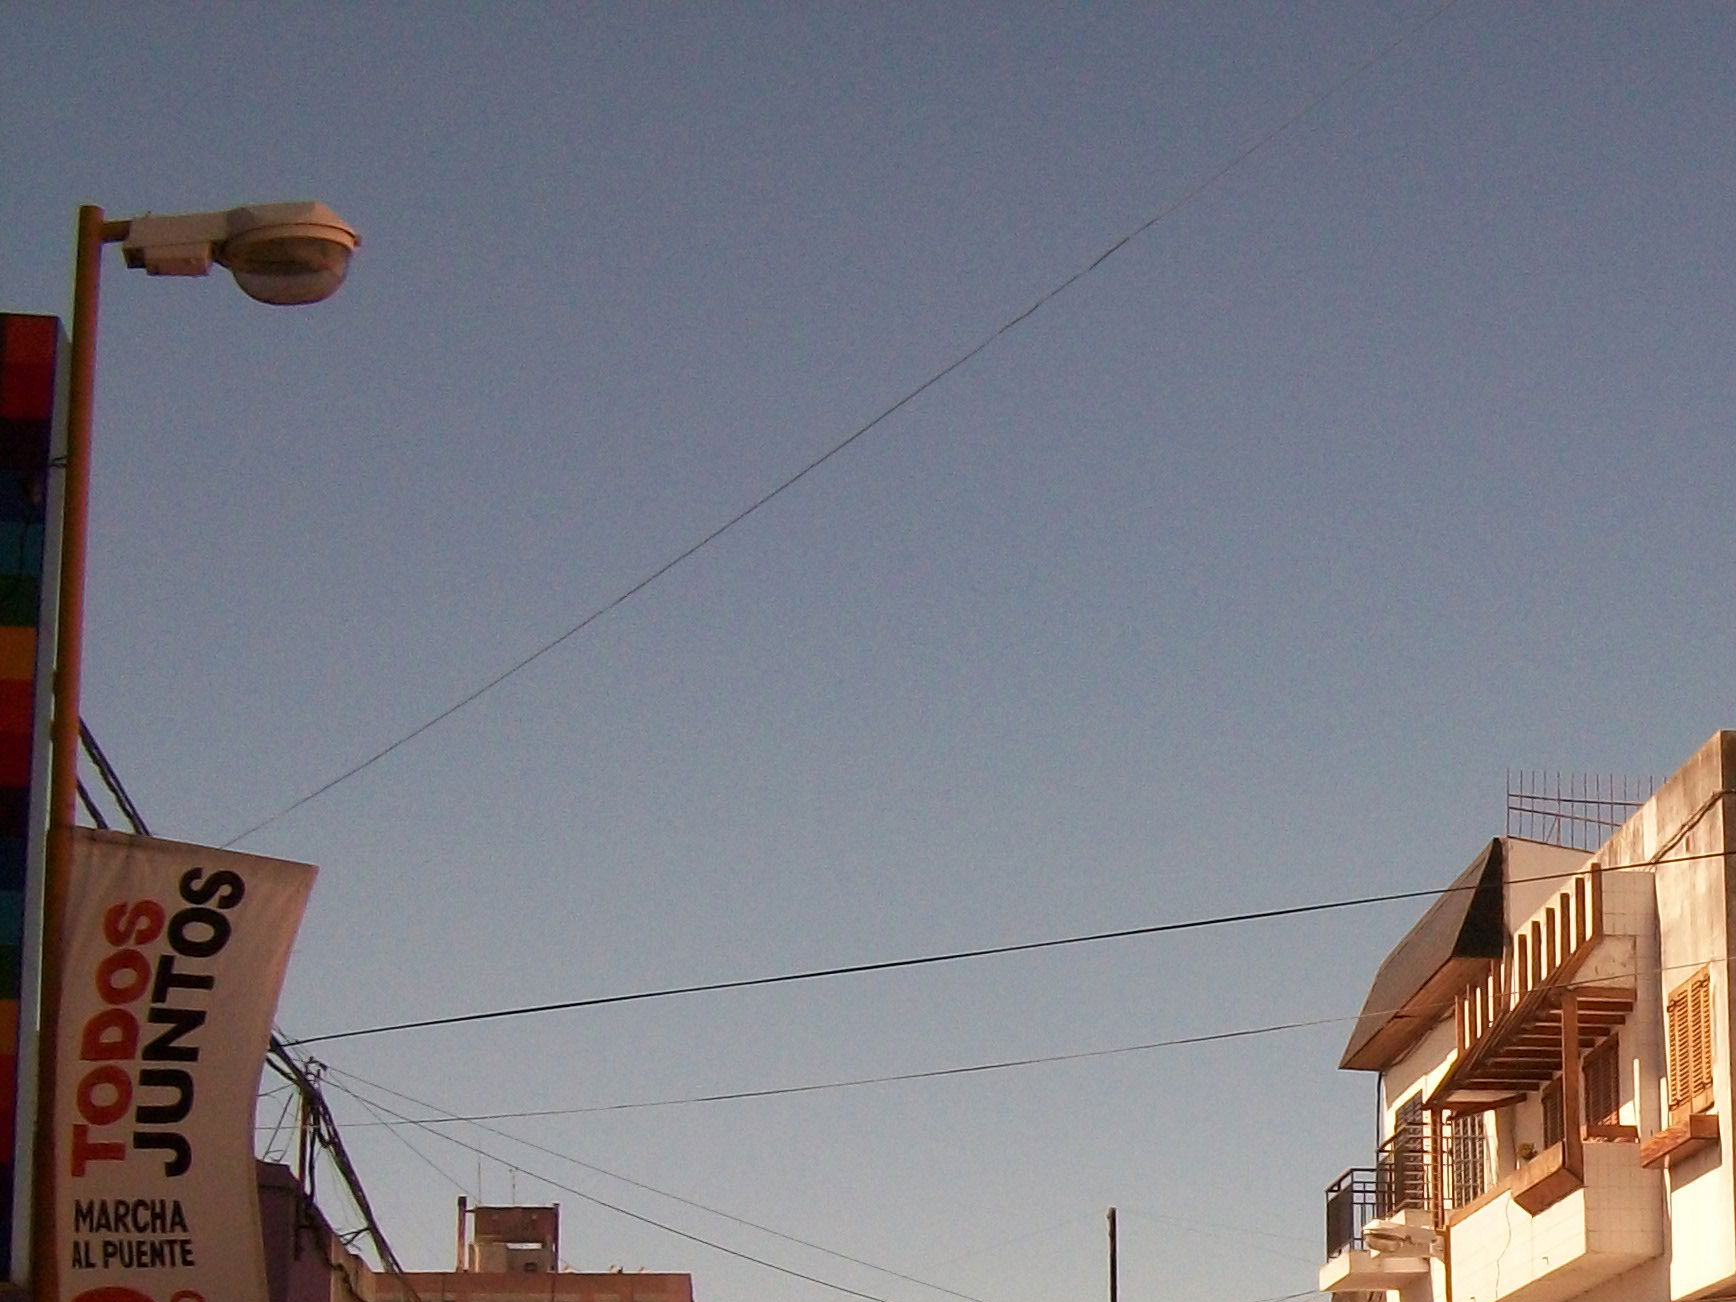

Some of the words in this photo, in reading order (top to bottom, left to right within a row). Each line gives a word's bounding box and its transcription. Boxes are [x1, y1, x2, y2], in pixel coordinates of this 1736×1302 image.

[72, 899, 165, 1177] TODOS
[133, 867, 245, 1177] JUNTOS
[72, 1240, 97, 1269] AL
[103, 1238, 195, 1269] PUENTE
[74, 1199, 188, 1234] MARCHA
